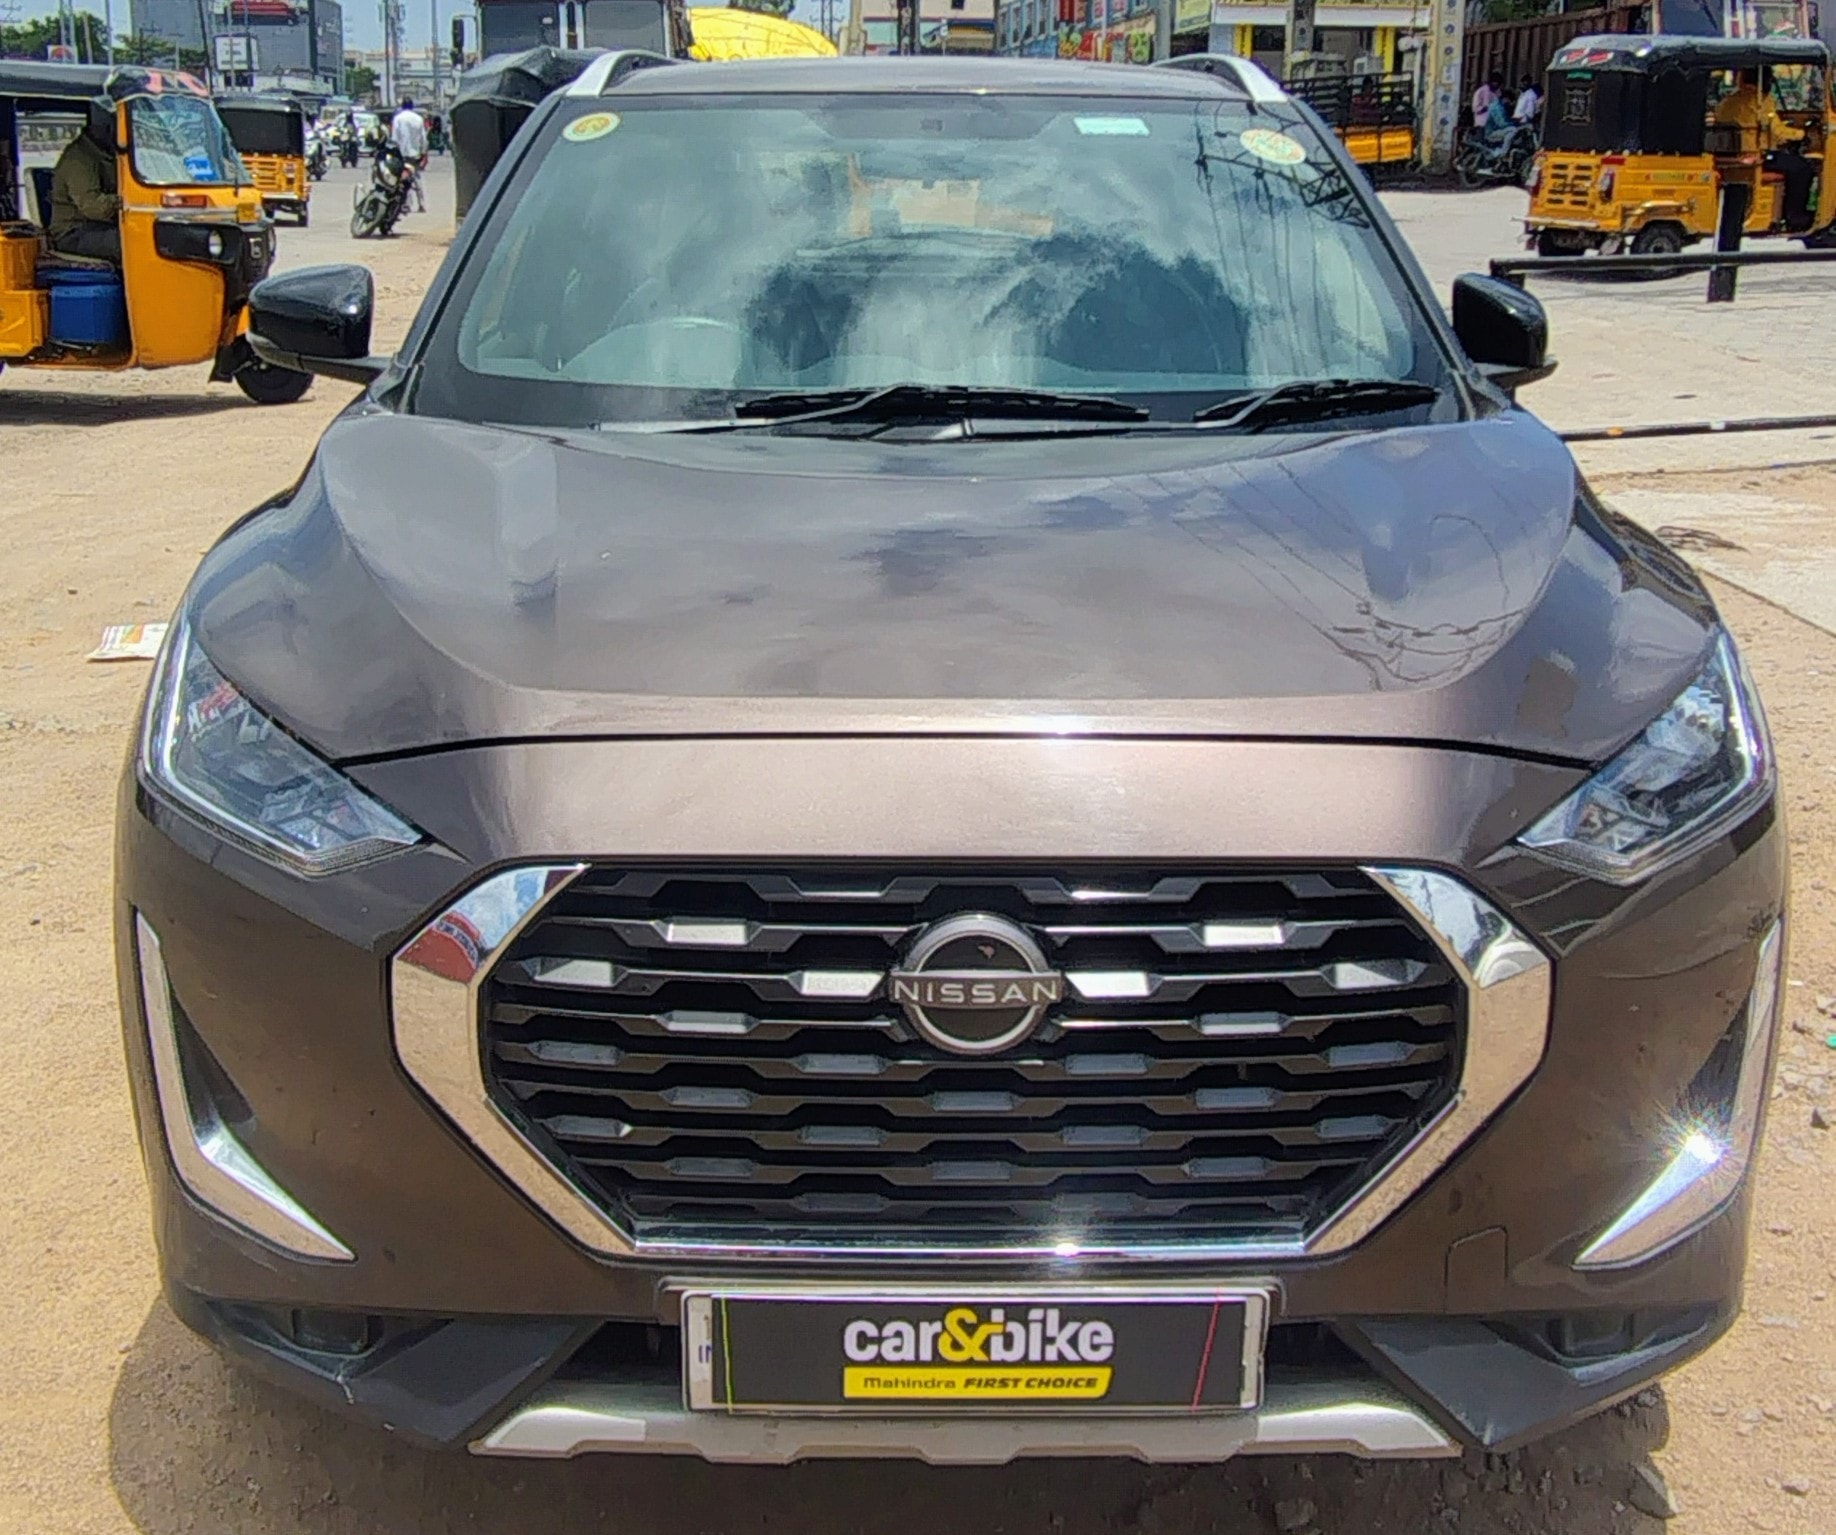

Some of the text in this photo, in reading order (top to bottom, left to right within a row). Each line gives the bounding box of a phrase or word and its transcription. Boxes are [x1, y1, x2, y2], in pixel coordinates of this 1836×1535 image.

[893, 980, 1058, 1004] NISSAN
[843, 1307, 1115, 1363] car&bike
[863, 1377, 1099, 1390] Mahindra FIRST CHOICE
